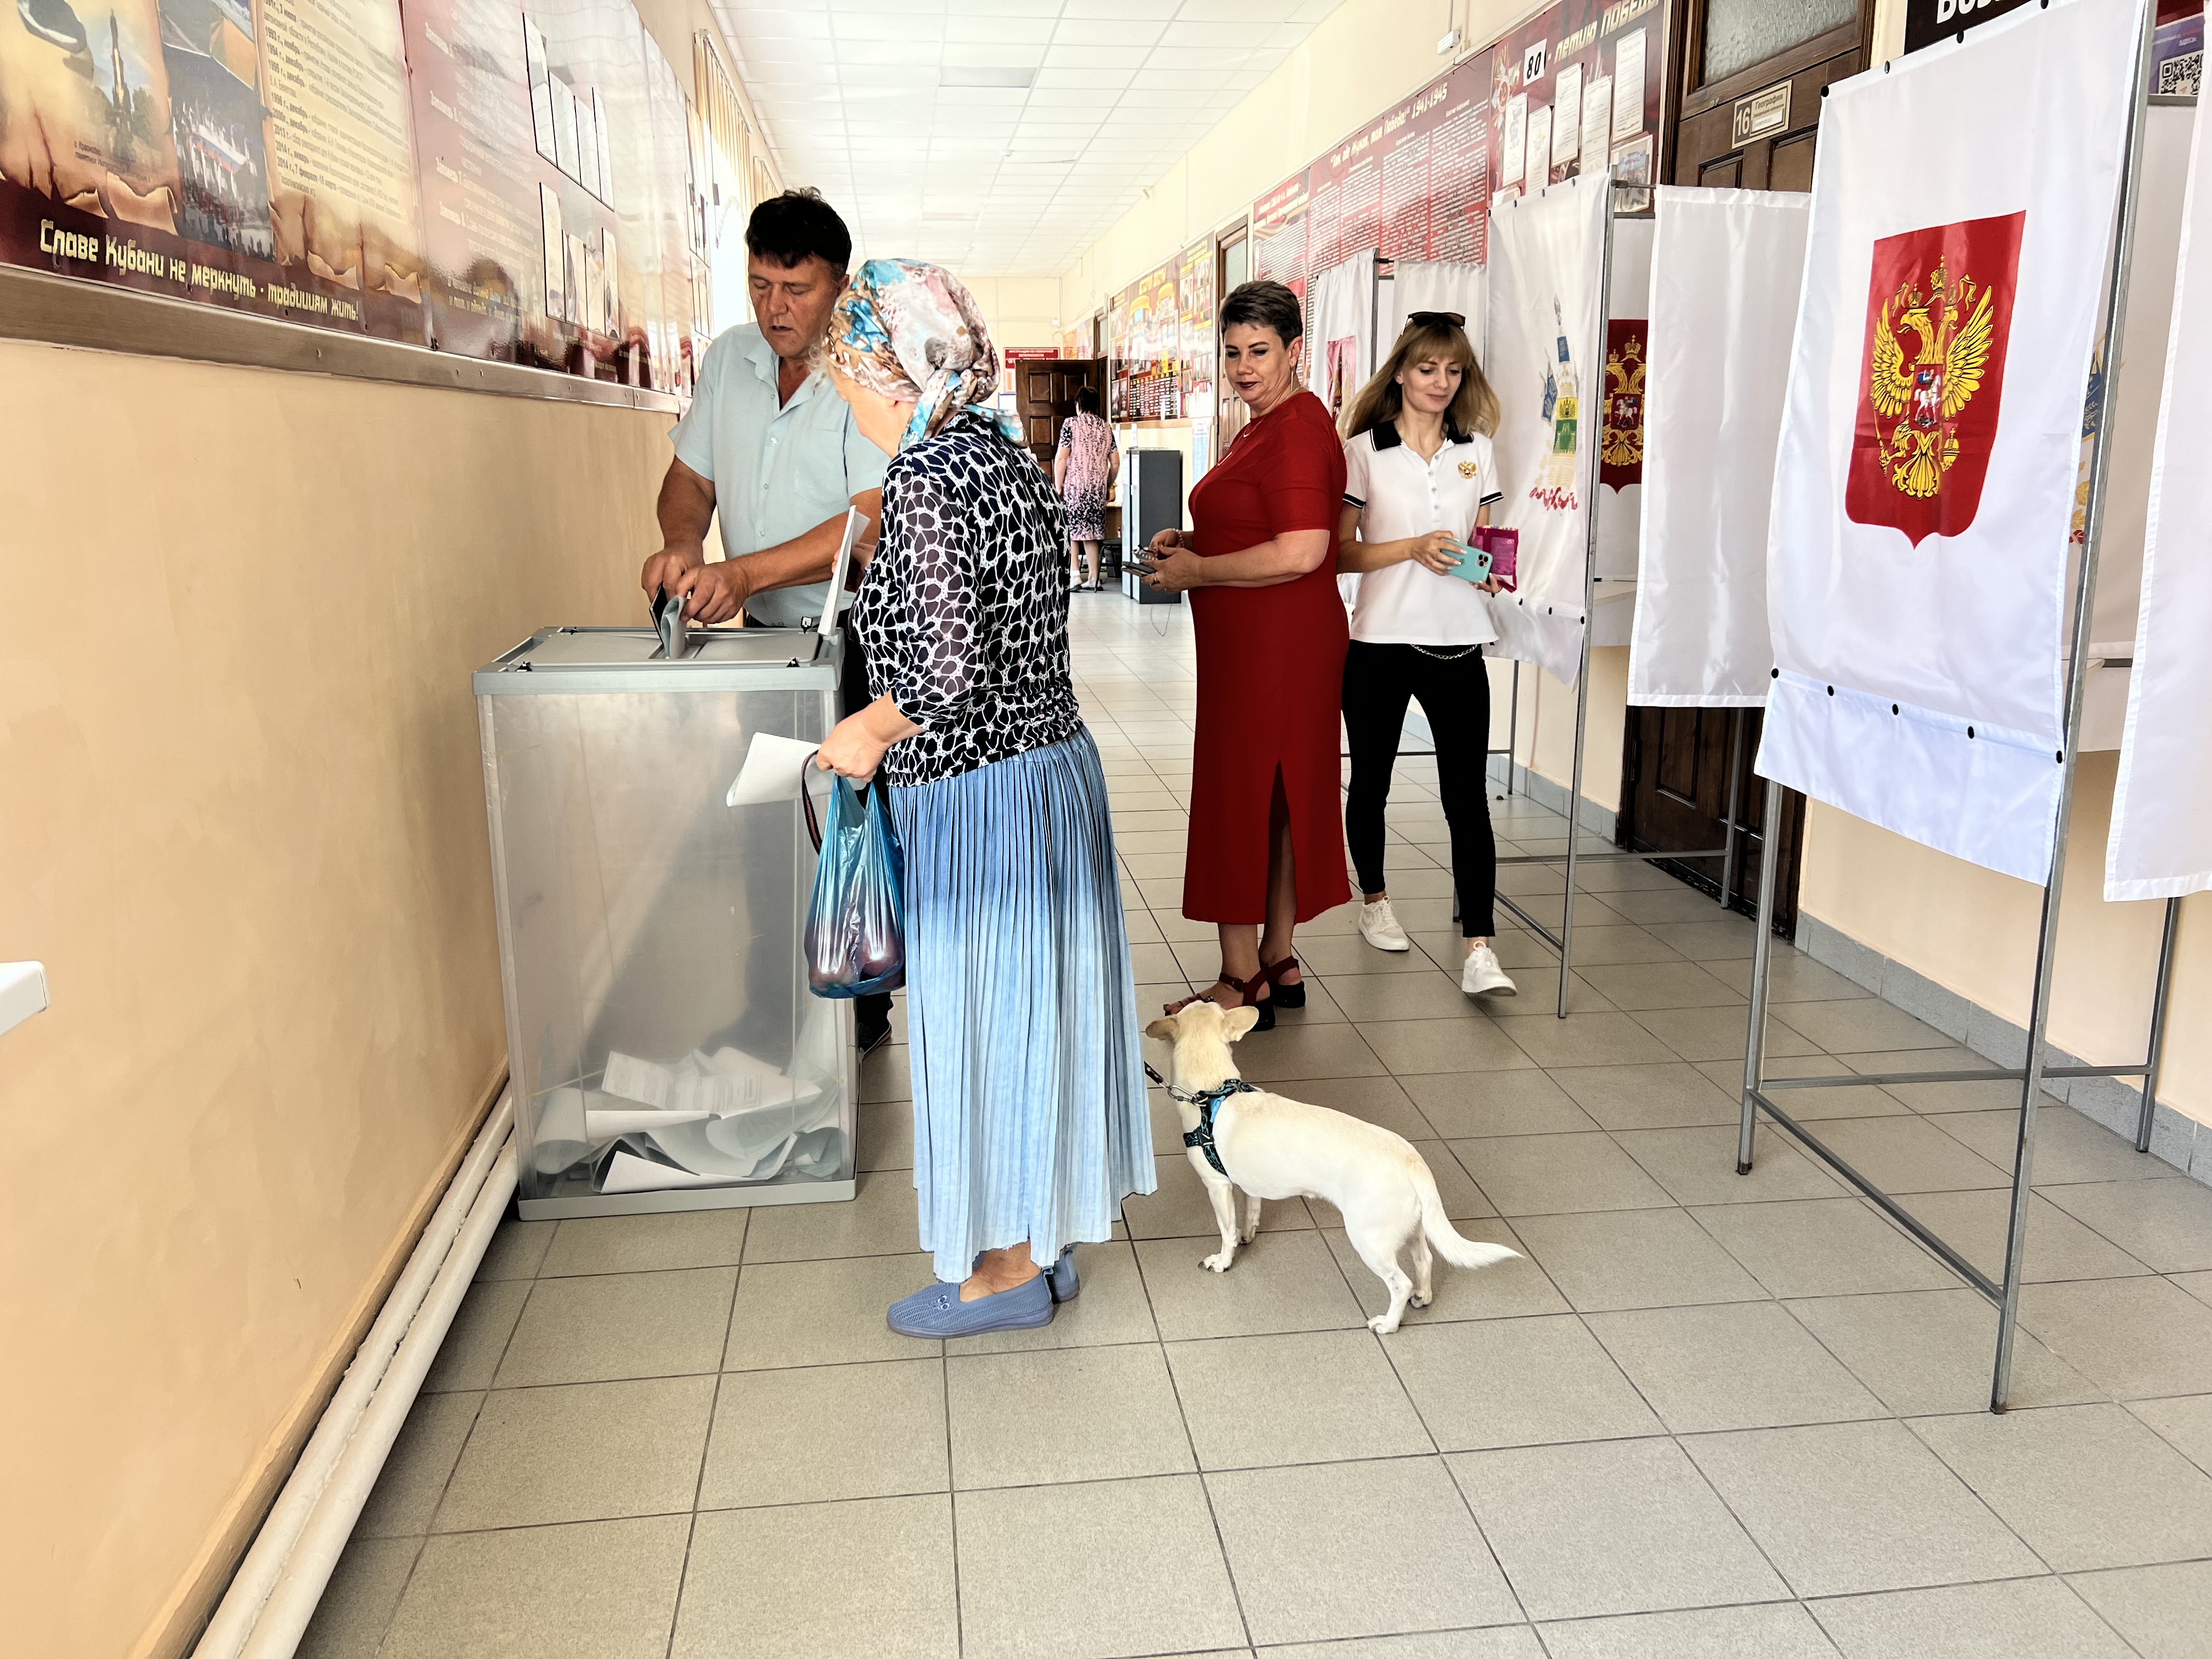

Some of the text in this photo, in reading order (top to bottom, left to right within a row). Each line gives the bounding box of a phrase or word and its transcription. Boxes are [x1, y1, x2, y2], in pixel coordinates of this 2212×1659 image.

[1527, 52, 1542, 80] 80
[1554, 20, 1598, 64] летию
[1736, 106, 1751, 137] 16
[1755, 93, 1784, 110] География
[40, 218, 99, 262] Славе
[105, 234, 164, 276] Кубани
[170, 257, 186, 283] не
[191, 263, 256, 301] меркнуть
[267, 282, 328, 315] традициям
[331, 298, 359, 321] жить!
